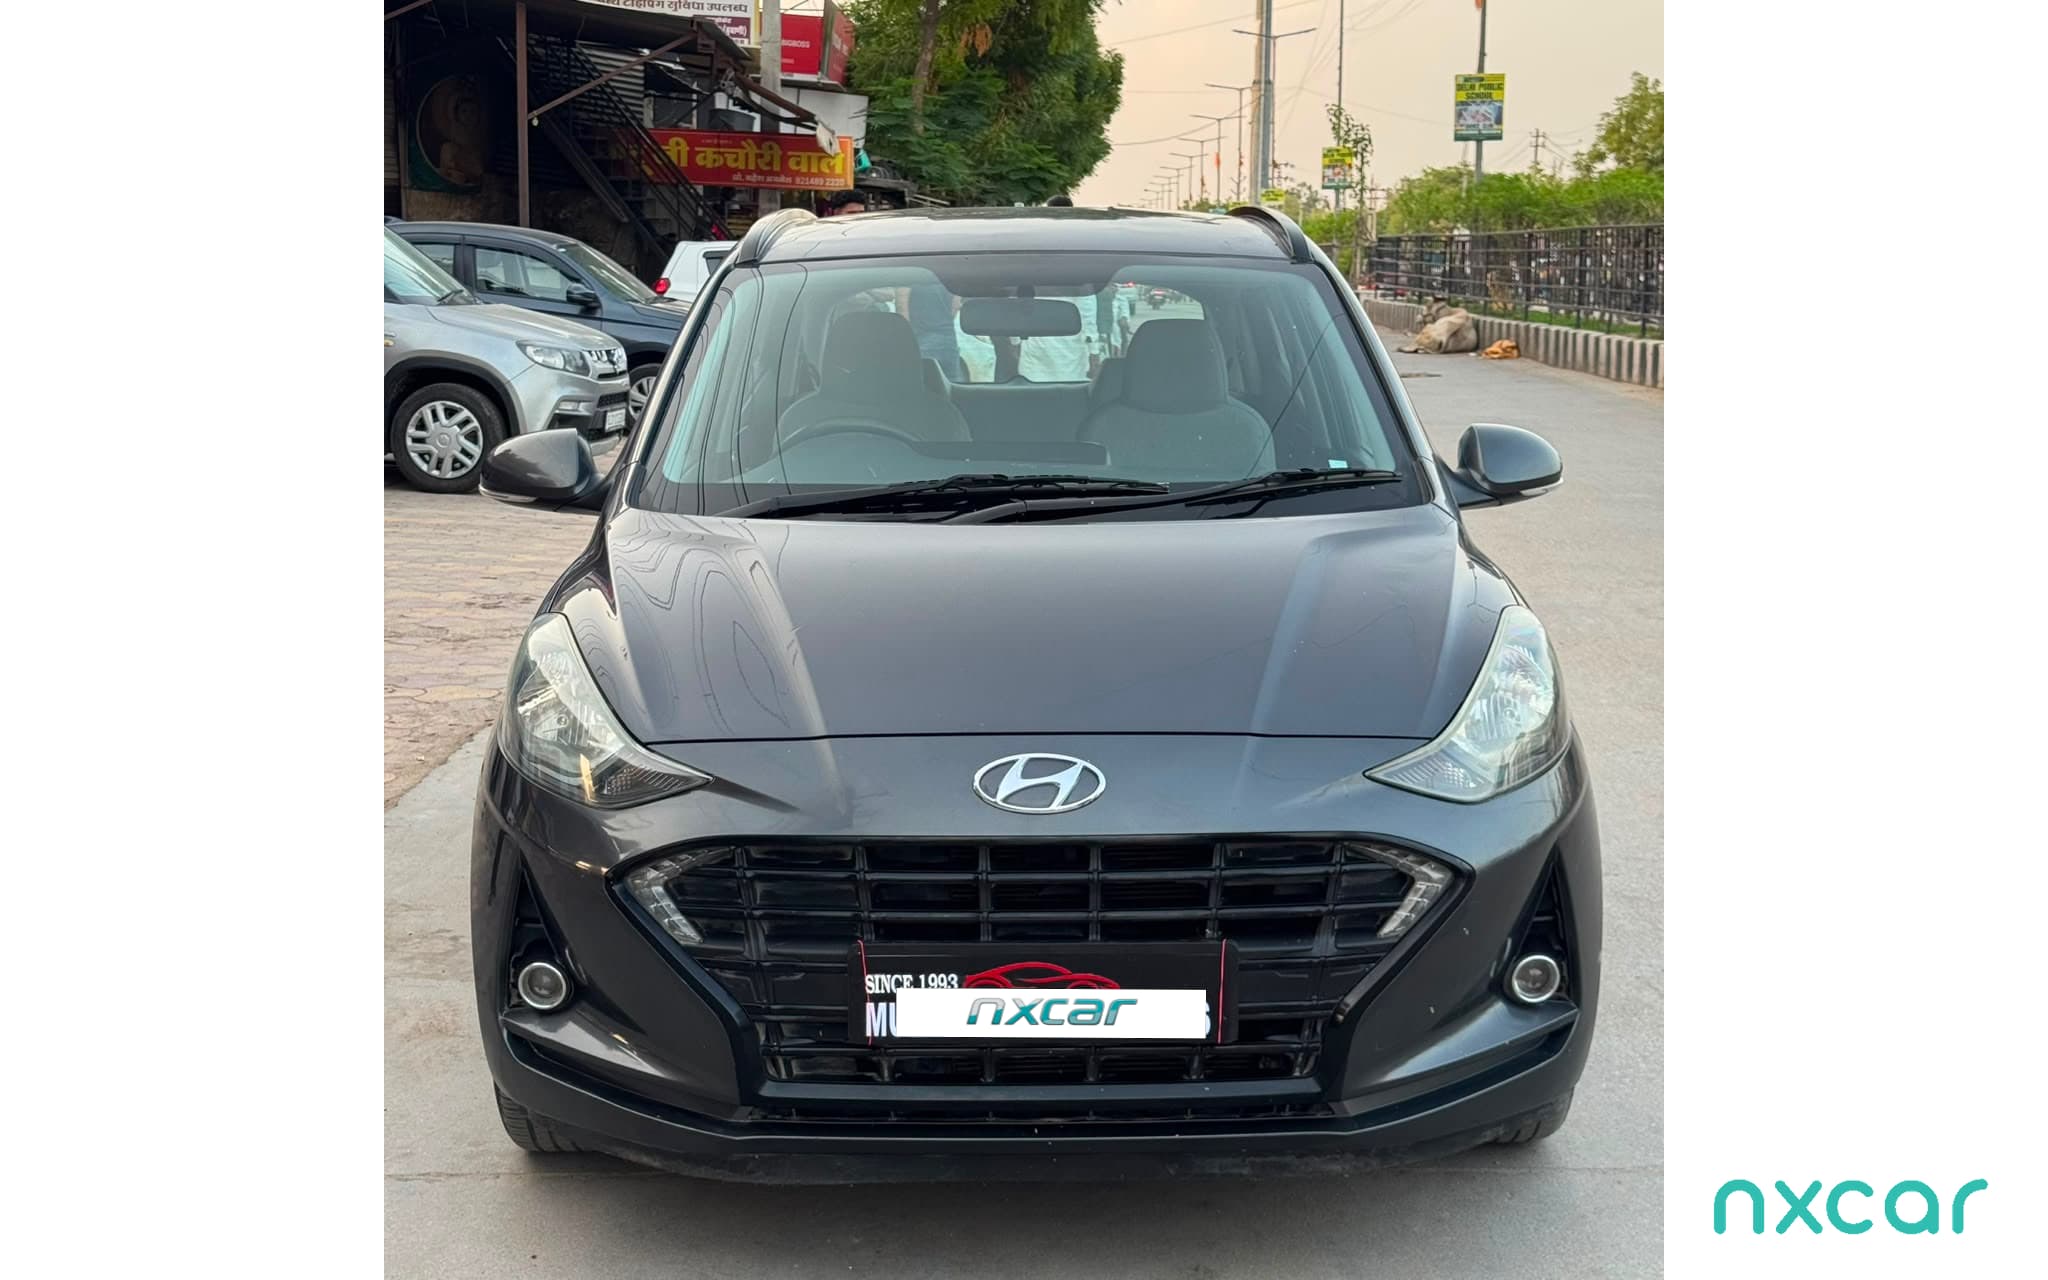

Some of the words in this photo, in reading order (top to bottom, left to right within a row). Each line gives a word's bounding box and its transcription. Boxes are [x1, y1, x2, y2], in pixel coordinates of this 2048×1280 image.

[695, 138, 782, 172] कचौरी
[865, 973, 913, 994] SINCE
[919, 973, 959, 989] 1993
